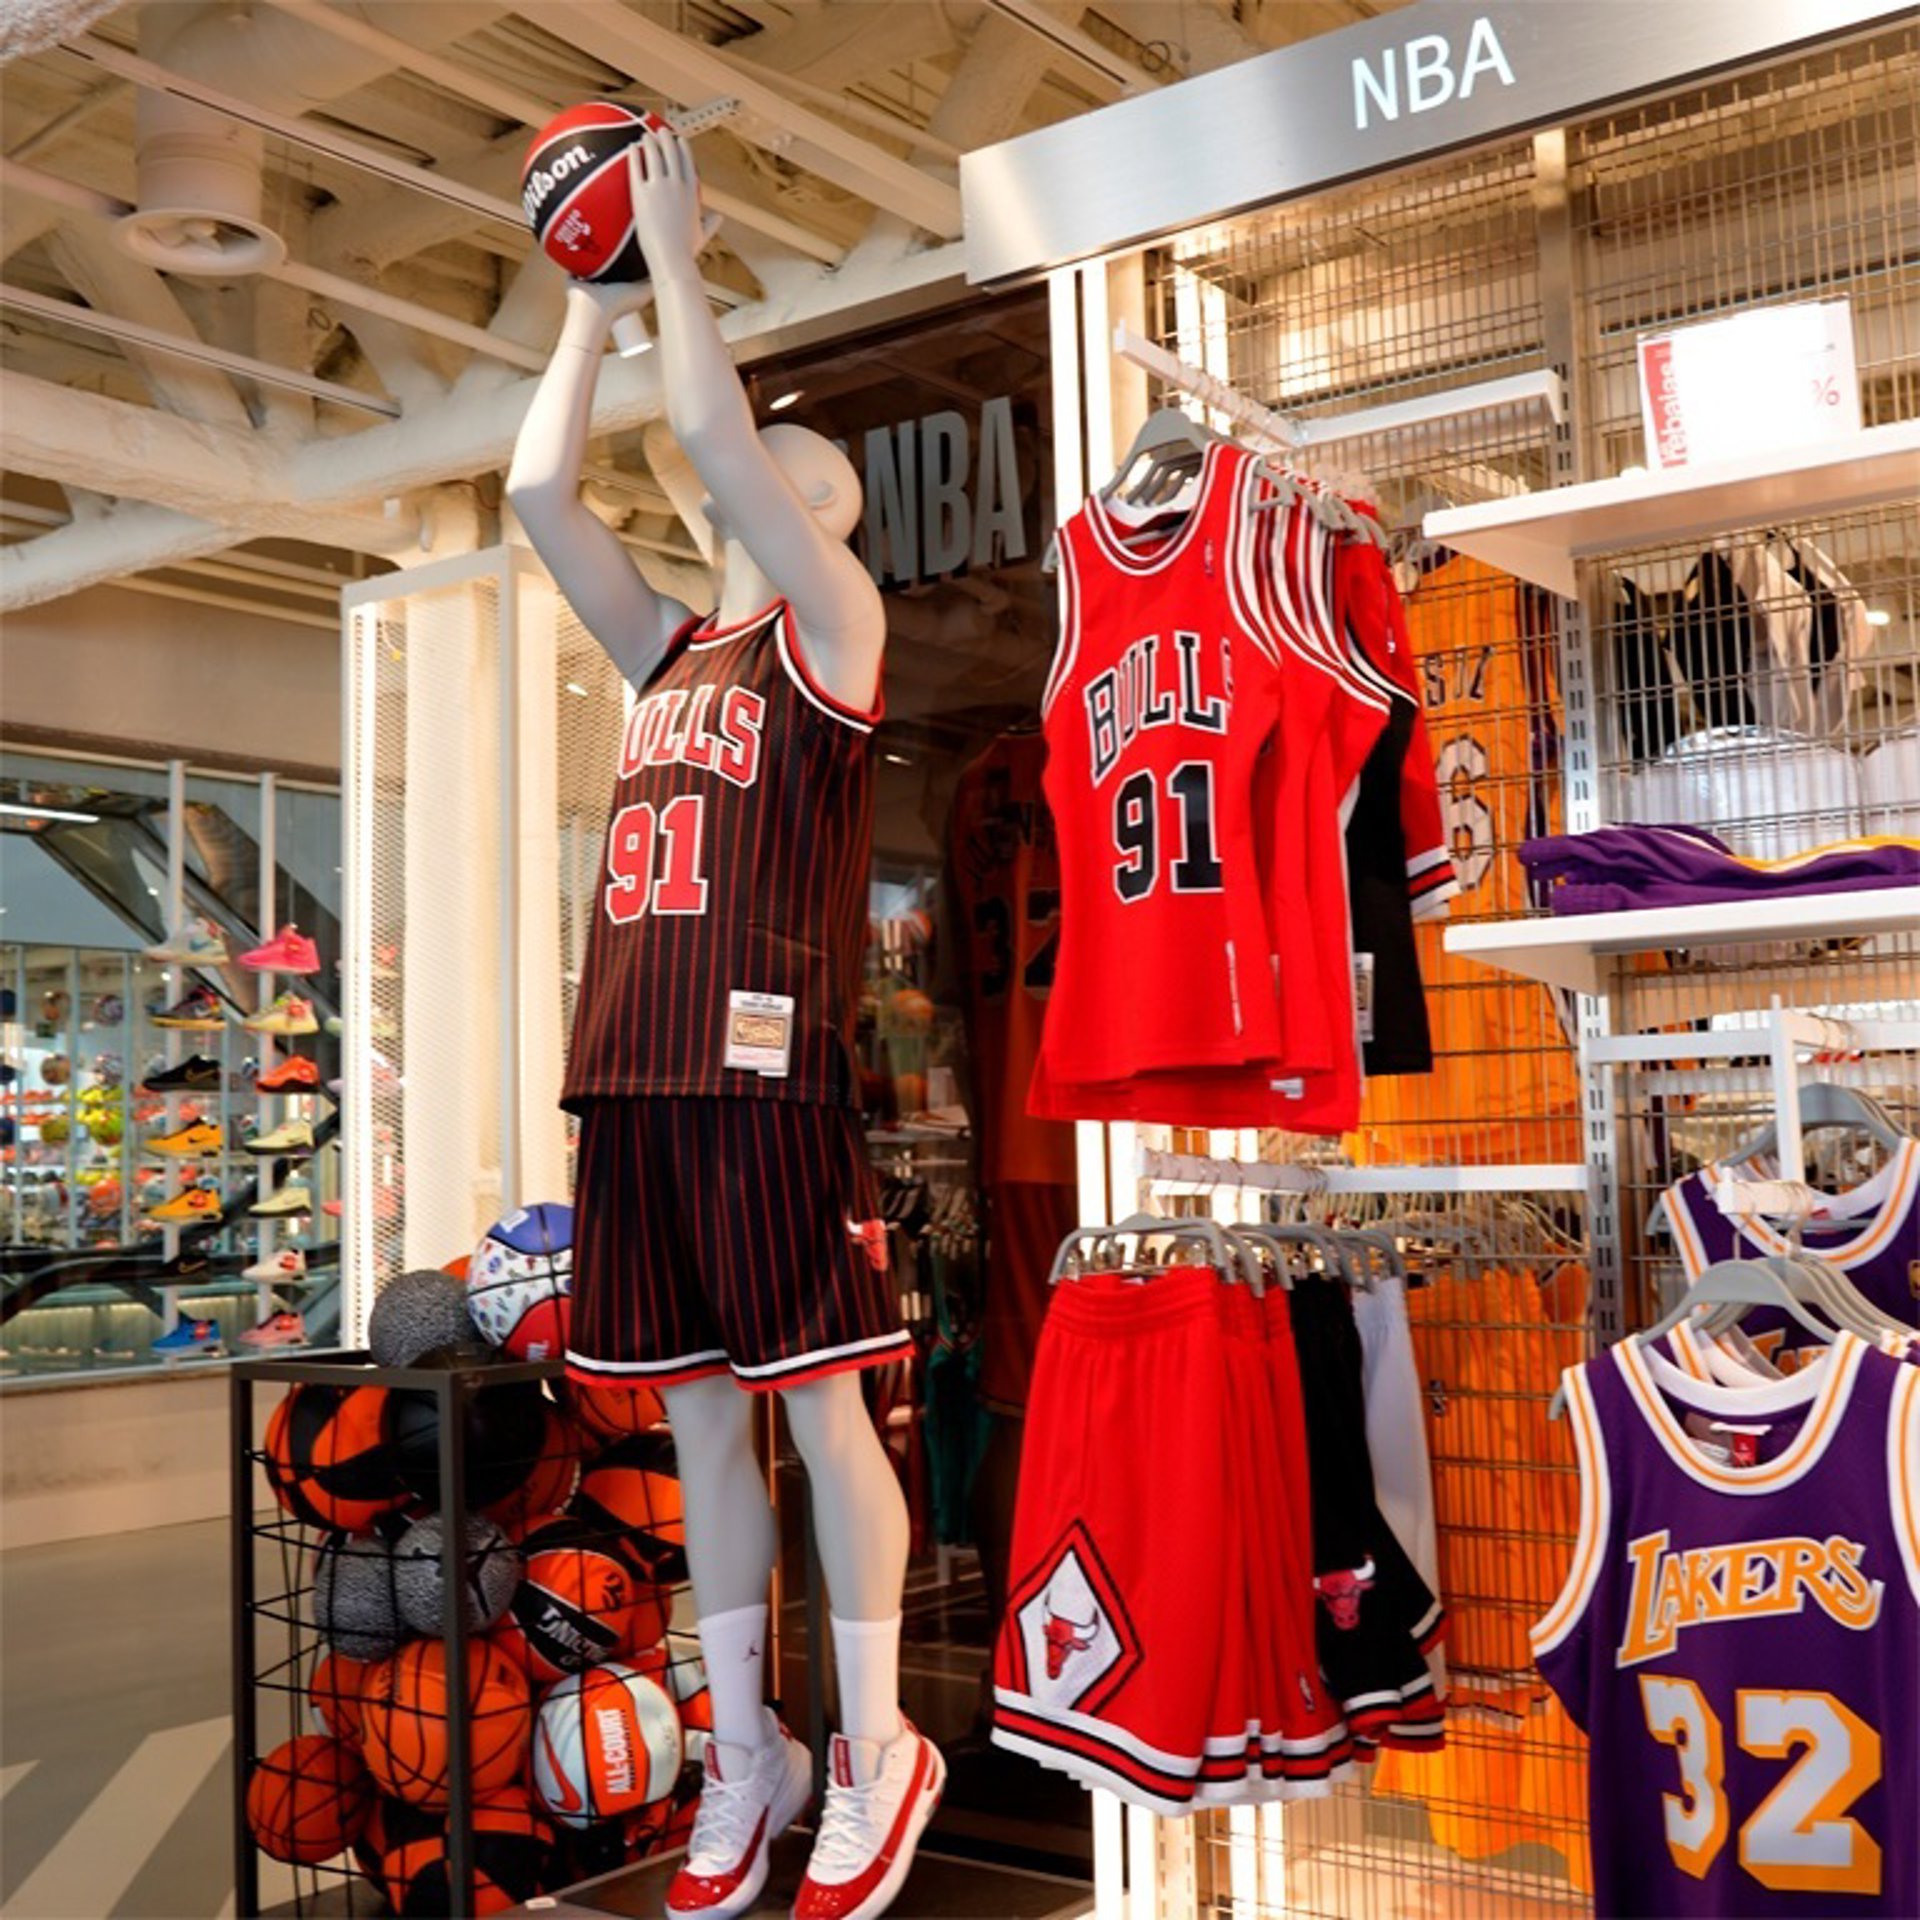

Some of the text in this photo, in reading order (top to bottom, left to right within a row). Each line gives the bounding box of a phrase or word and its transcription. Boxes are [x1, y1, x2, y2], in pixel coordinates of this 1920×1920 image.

[1352, 16, 1516, 130] NBA
[865, 396, 1027, 586] NBA
[617, 684, 766, 788] ULLS
[605, 795, 709, 925] 91
[1113, 759, 1225, 905] 91
[1615, 1529, 1885, 1669] LAKERS
[1638, 1673, 1882, 1896] 32
